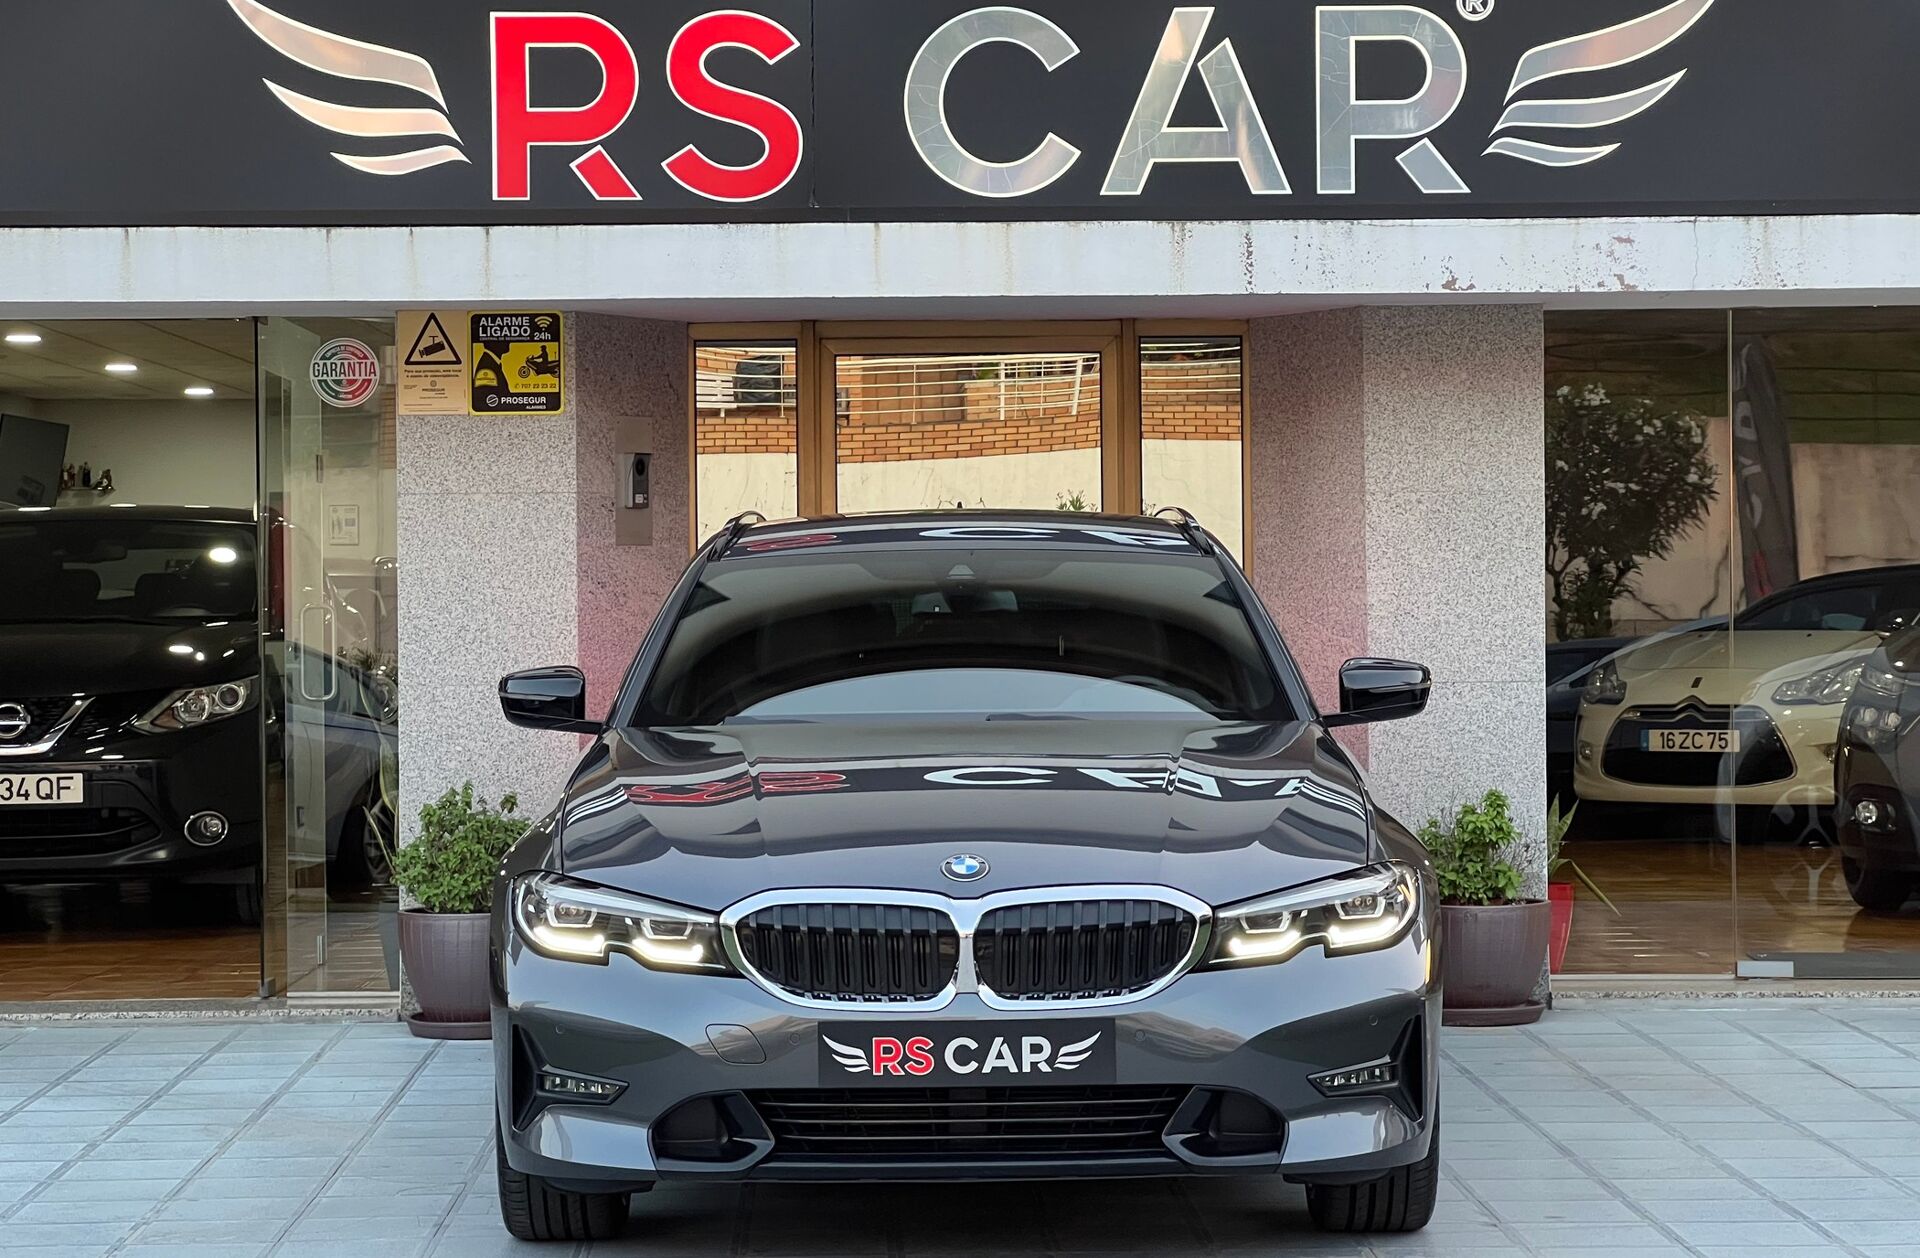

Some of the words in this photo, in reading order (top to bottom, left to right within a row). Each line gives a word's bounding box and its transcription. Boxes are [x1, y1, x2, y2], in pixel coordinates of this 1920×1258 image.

[489, 9, 803, 202] RS
[903, 6, 1471, 197] CAR
[480, 317, 530, 326] ALARME
[479, 326, 531, 337] LIGADO
[533, 332, 551, 340] 24h
[312, 361, 377, 378] GARANTIA
[501, 396, 546, 404] PROSEGUR
[872, 1036, 935, 1076] RS
[944, 1036, 1053, 1074] CAR
